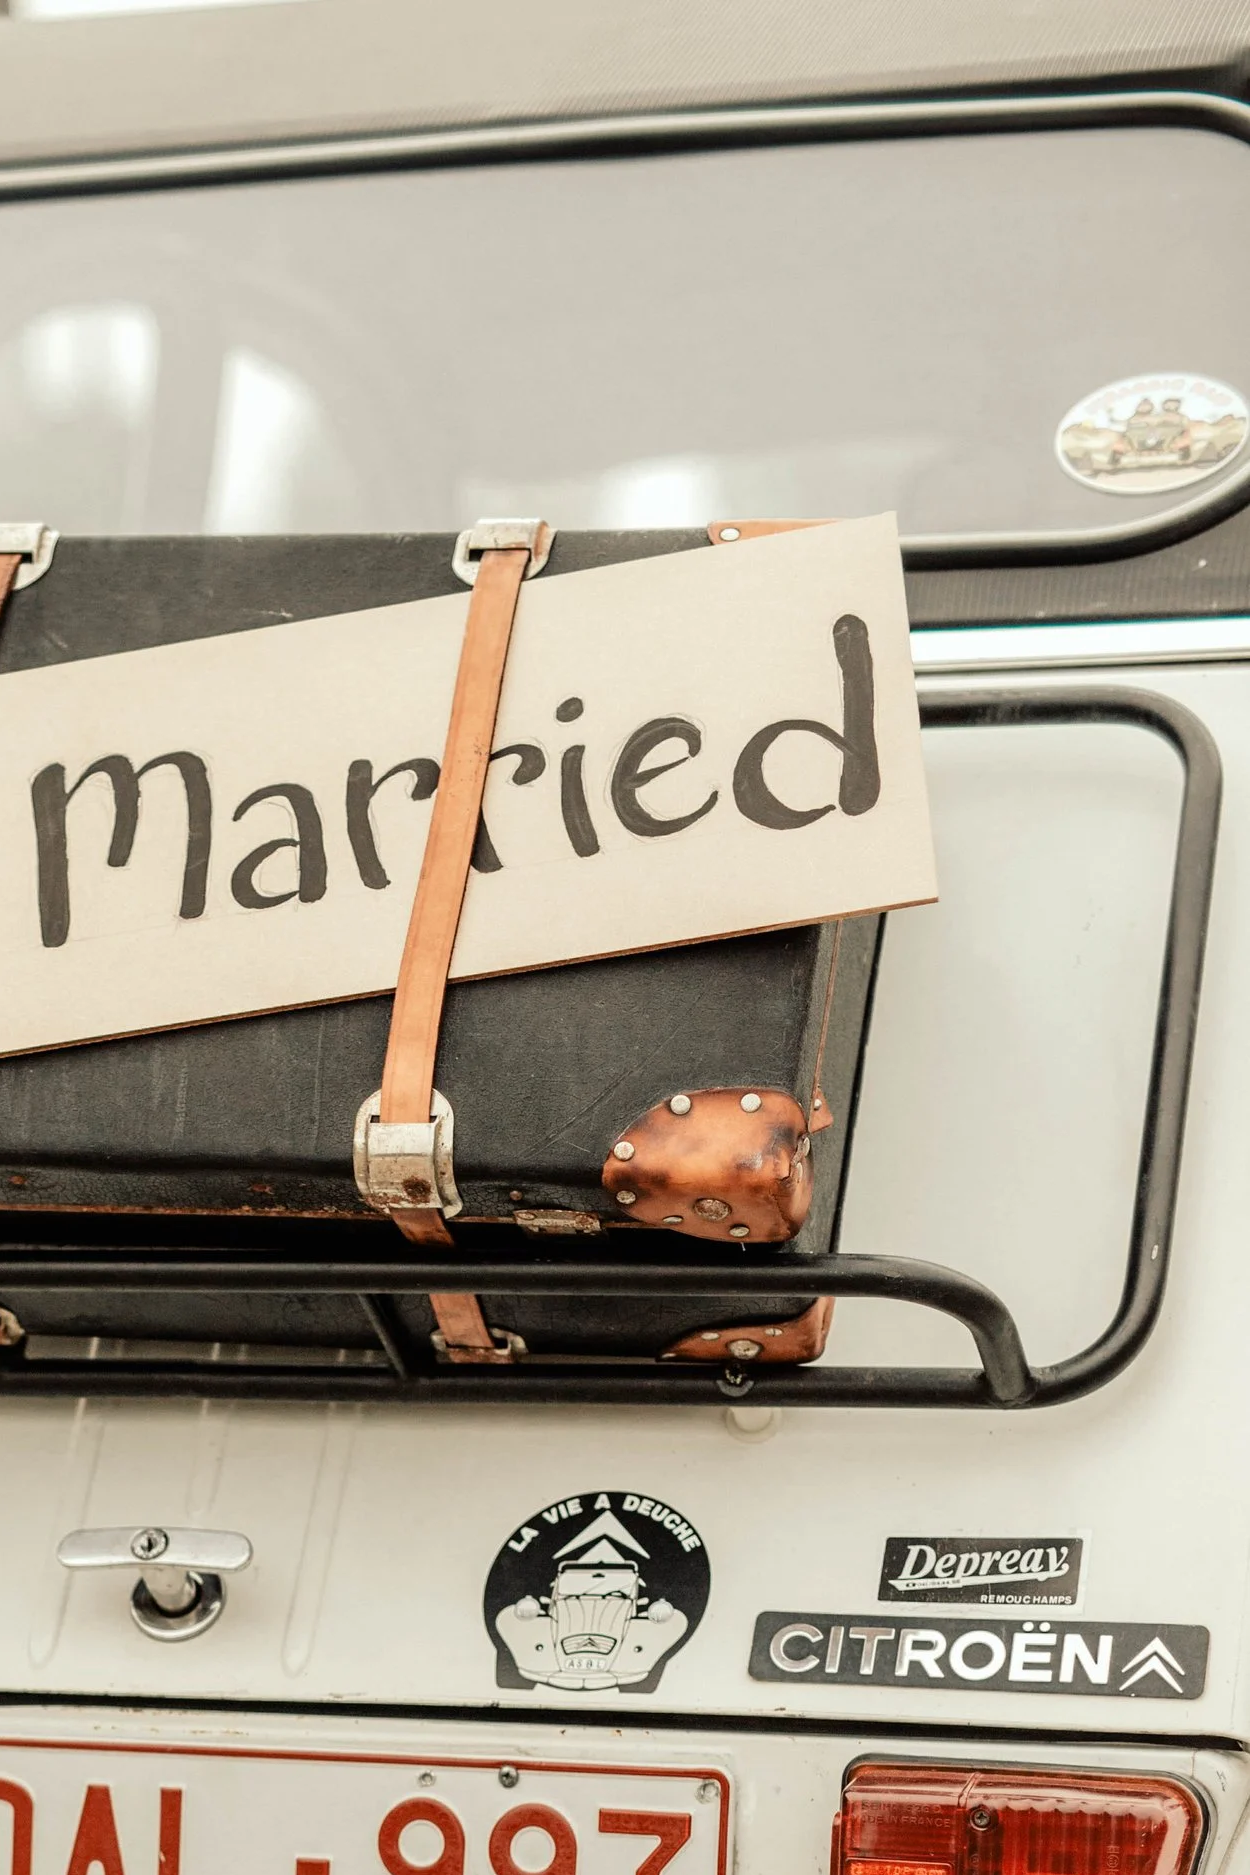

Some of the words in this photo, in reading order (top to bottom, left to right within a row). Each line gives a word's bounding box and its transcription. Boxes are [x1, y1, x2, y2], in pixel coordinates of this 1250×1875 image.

[507, 1526, 539, 1552] LA
[541, 1498, 583, 1524] VIE
[594, 1493, 611, 1509] A
[622, 1494, 701, 1552] DEUCHE
[769, 1621, 1113, 1684] CITROËN
